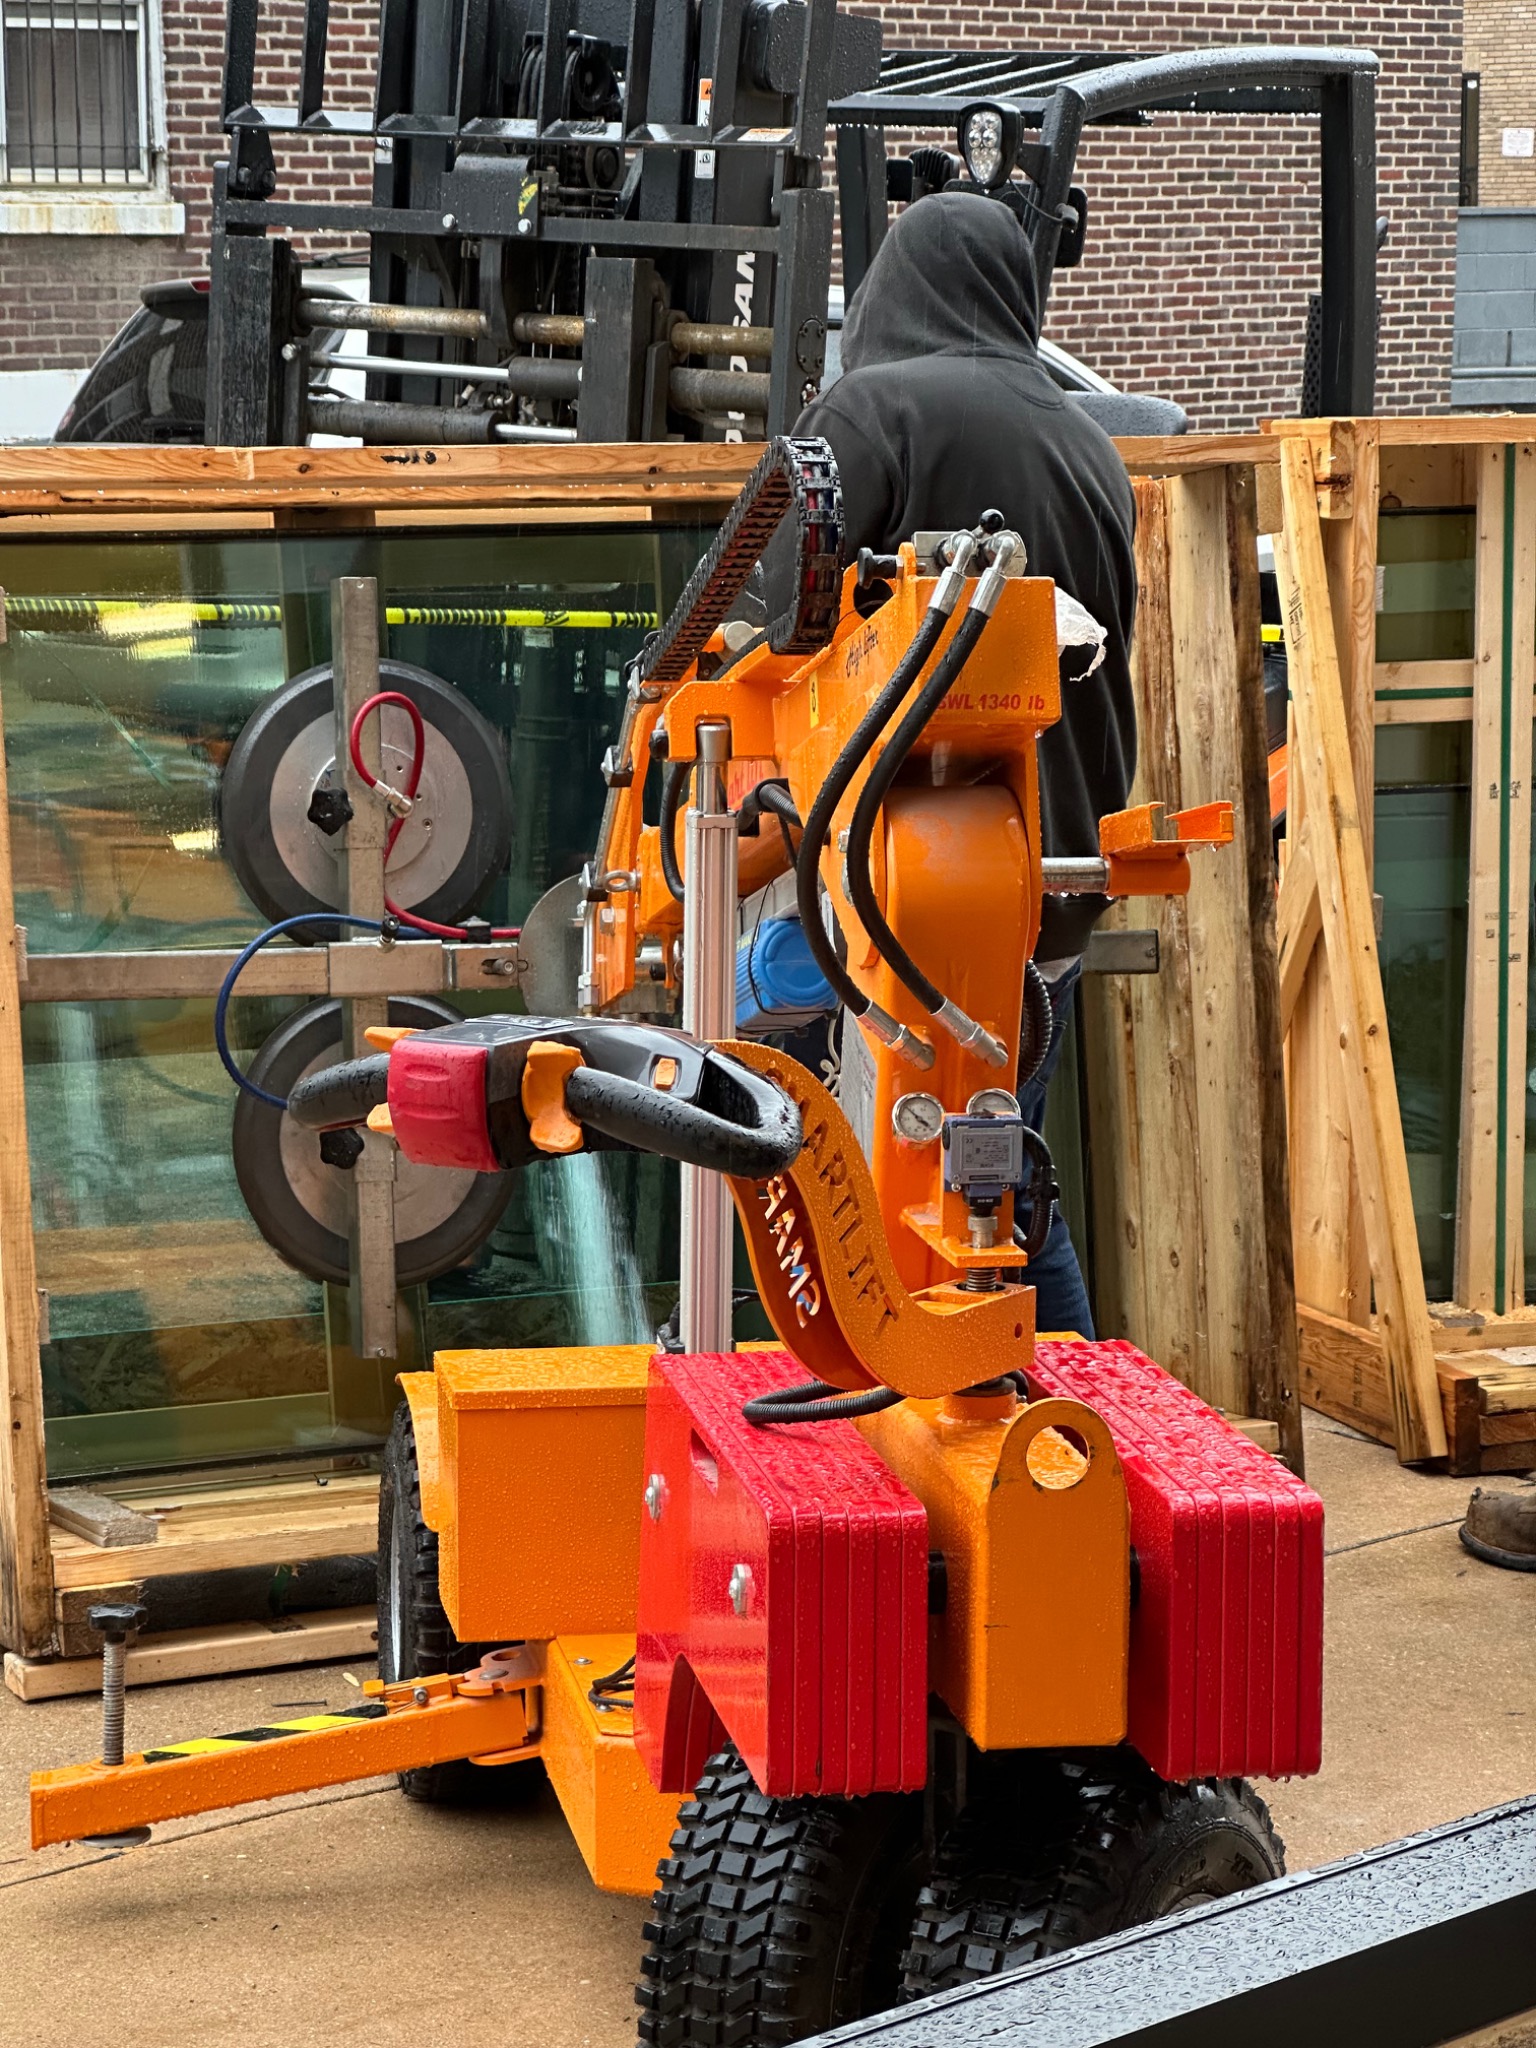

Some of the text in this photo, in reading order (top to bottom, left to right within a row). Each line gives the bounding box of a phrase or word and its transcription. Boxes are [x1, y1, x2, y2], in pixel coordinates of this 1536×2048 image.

[979, 694, 1021, 710] 1340
[1027, 695, 1045, 710] lb
[765, 1068, 899, 1336] ARTLIFT
